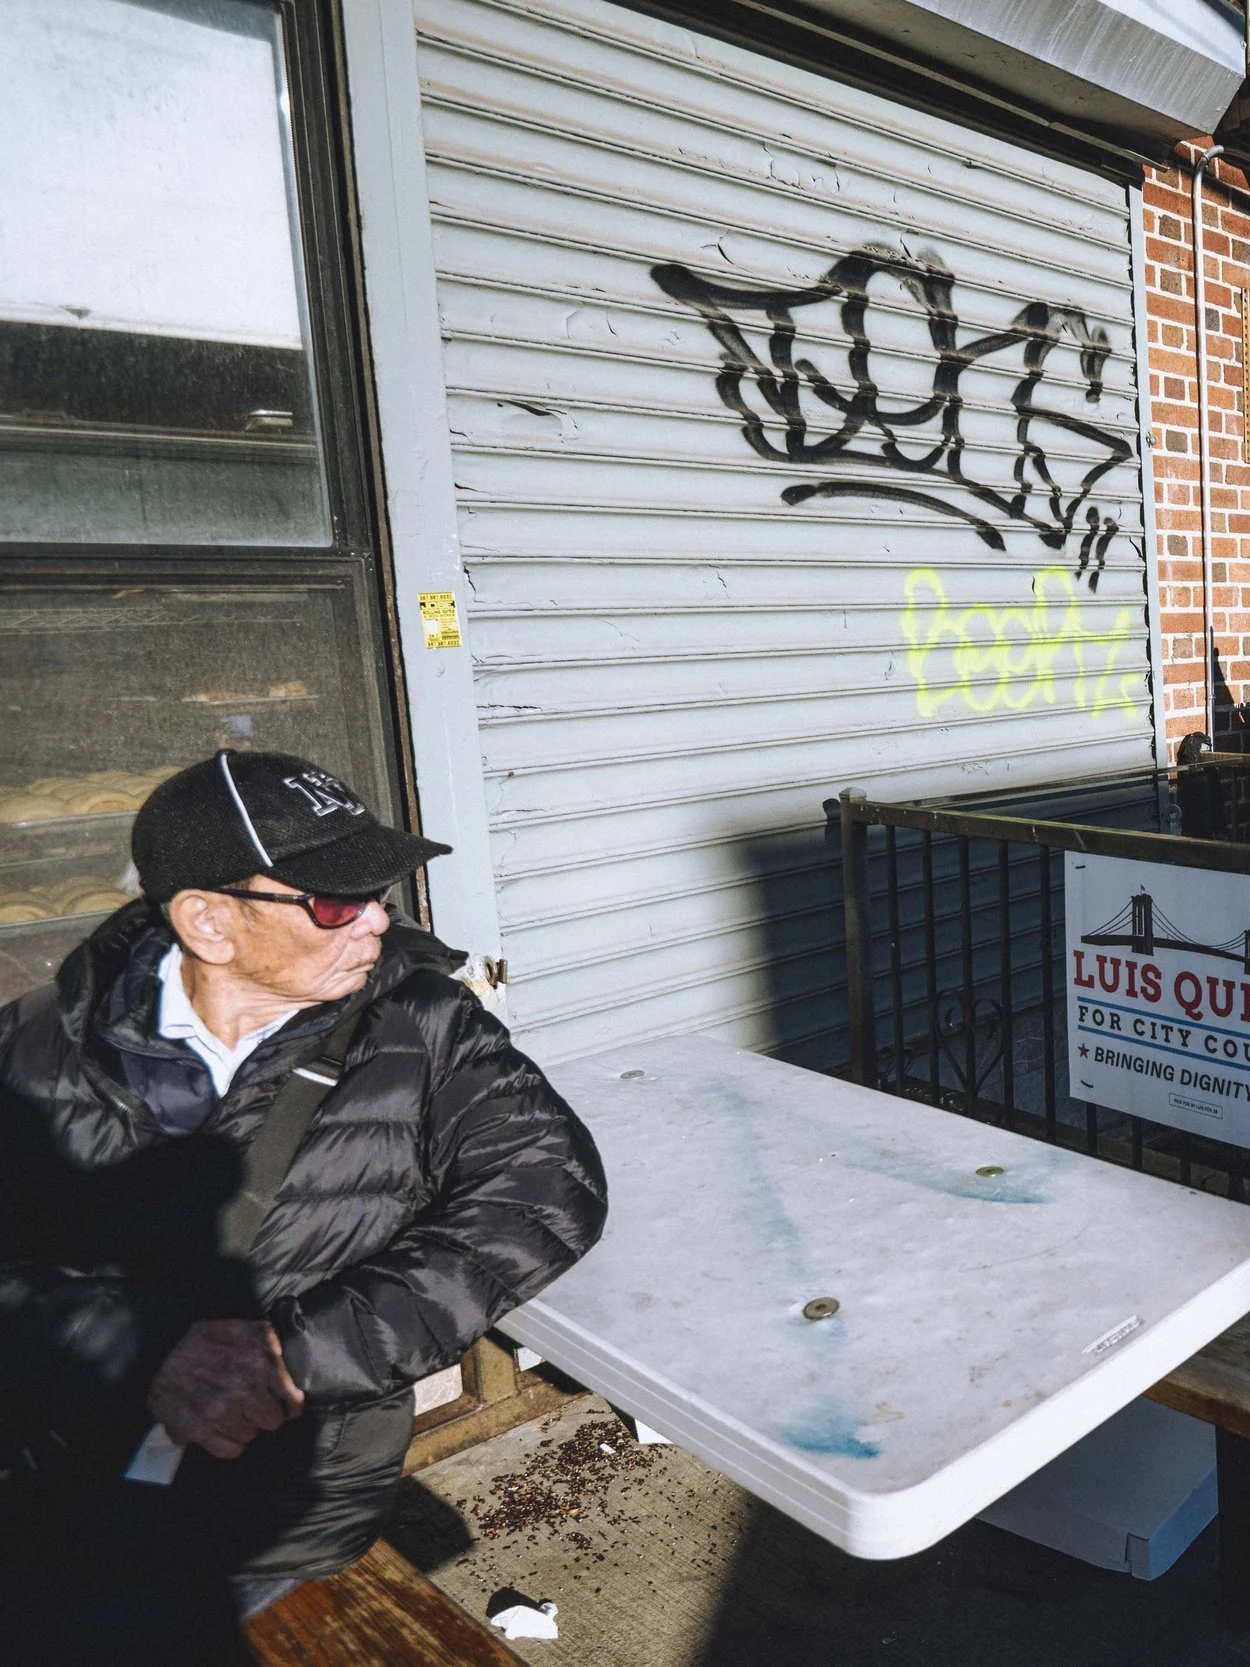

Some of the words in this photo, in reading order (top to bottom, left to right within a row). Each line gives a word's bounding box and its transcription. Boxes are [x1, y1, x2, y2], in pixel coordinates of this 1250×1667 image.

[1073, 950, 1162, 1003] LUIS
[1078, 1004, 1121, 1031] FOR
[1133, 1018, 1192, 1047] CITY
[1094, 1046, 1175, 1082] BRINGING
